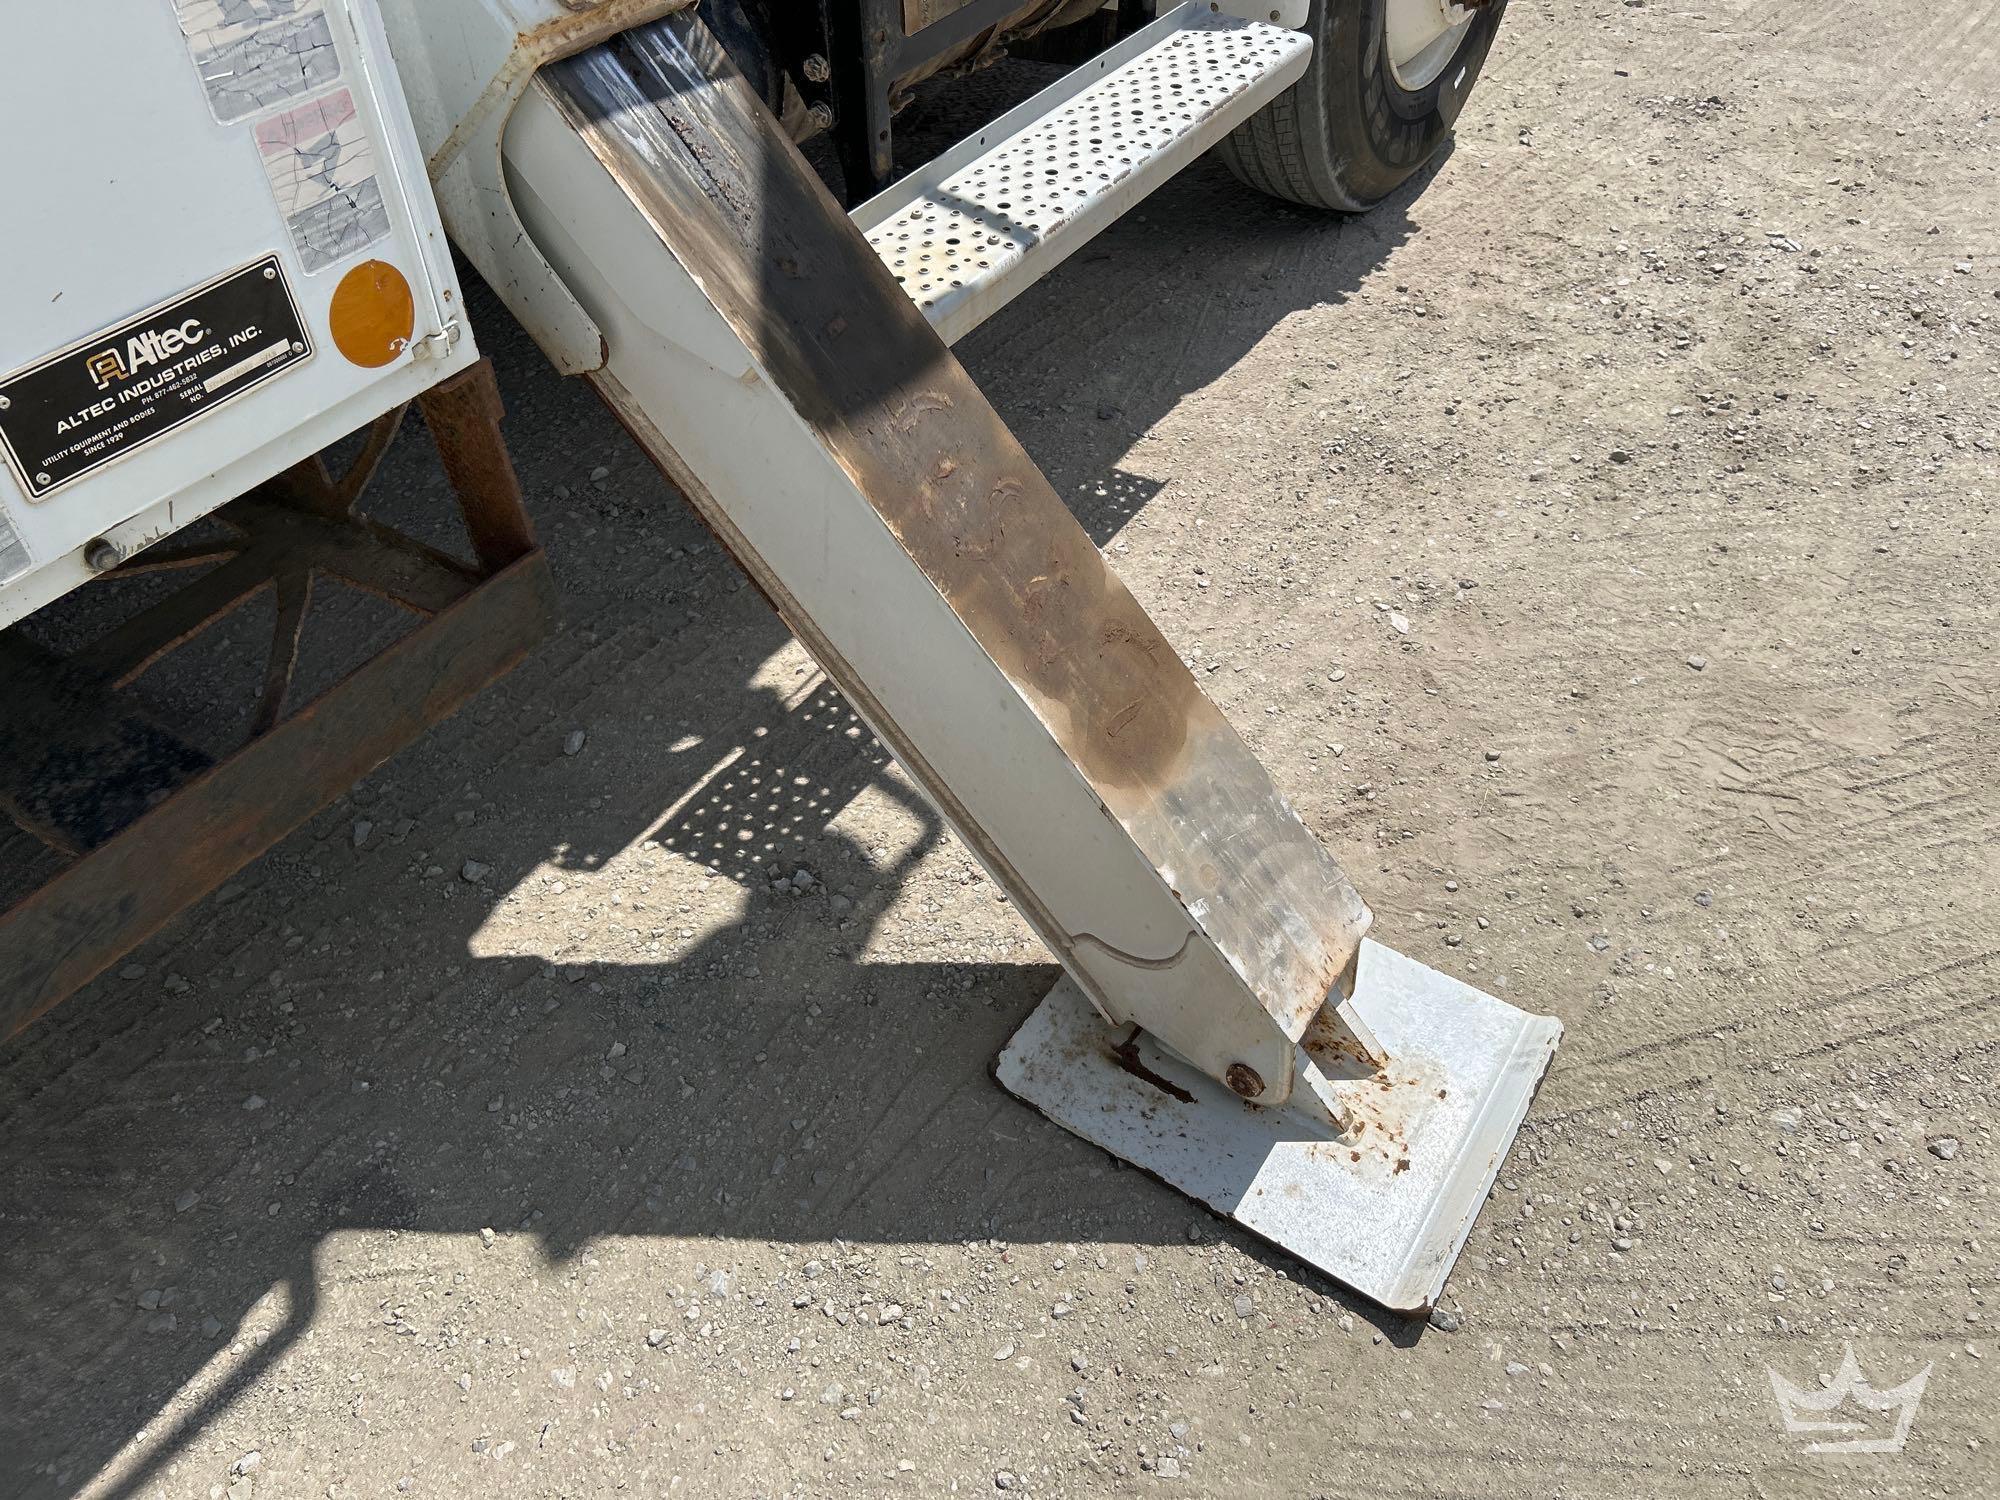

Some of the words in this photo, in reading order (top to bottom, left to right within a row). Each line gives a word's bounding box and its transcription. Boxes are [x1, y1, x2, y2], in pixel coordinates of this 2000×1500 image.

[127, 319, 204, 375] Altec
[56, 397, 117, 435] ALTEC
[118, 344, 228, 404] INDUSTRIES,
[228, 326, 262, 348] INC.
[180, 383, 203, 400] SERIAL
[189, 393, 204, 403] NO.
[41, 449, 69, 467] UTILITY
[69, 427, 112, 454] EQUIPMENT
[113, 419, 129, 433] AND
[129, 406, 156, 424] BODIES
[83, 441, 106, 457] SINCE
[106, 432, 124, 445] 1929
